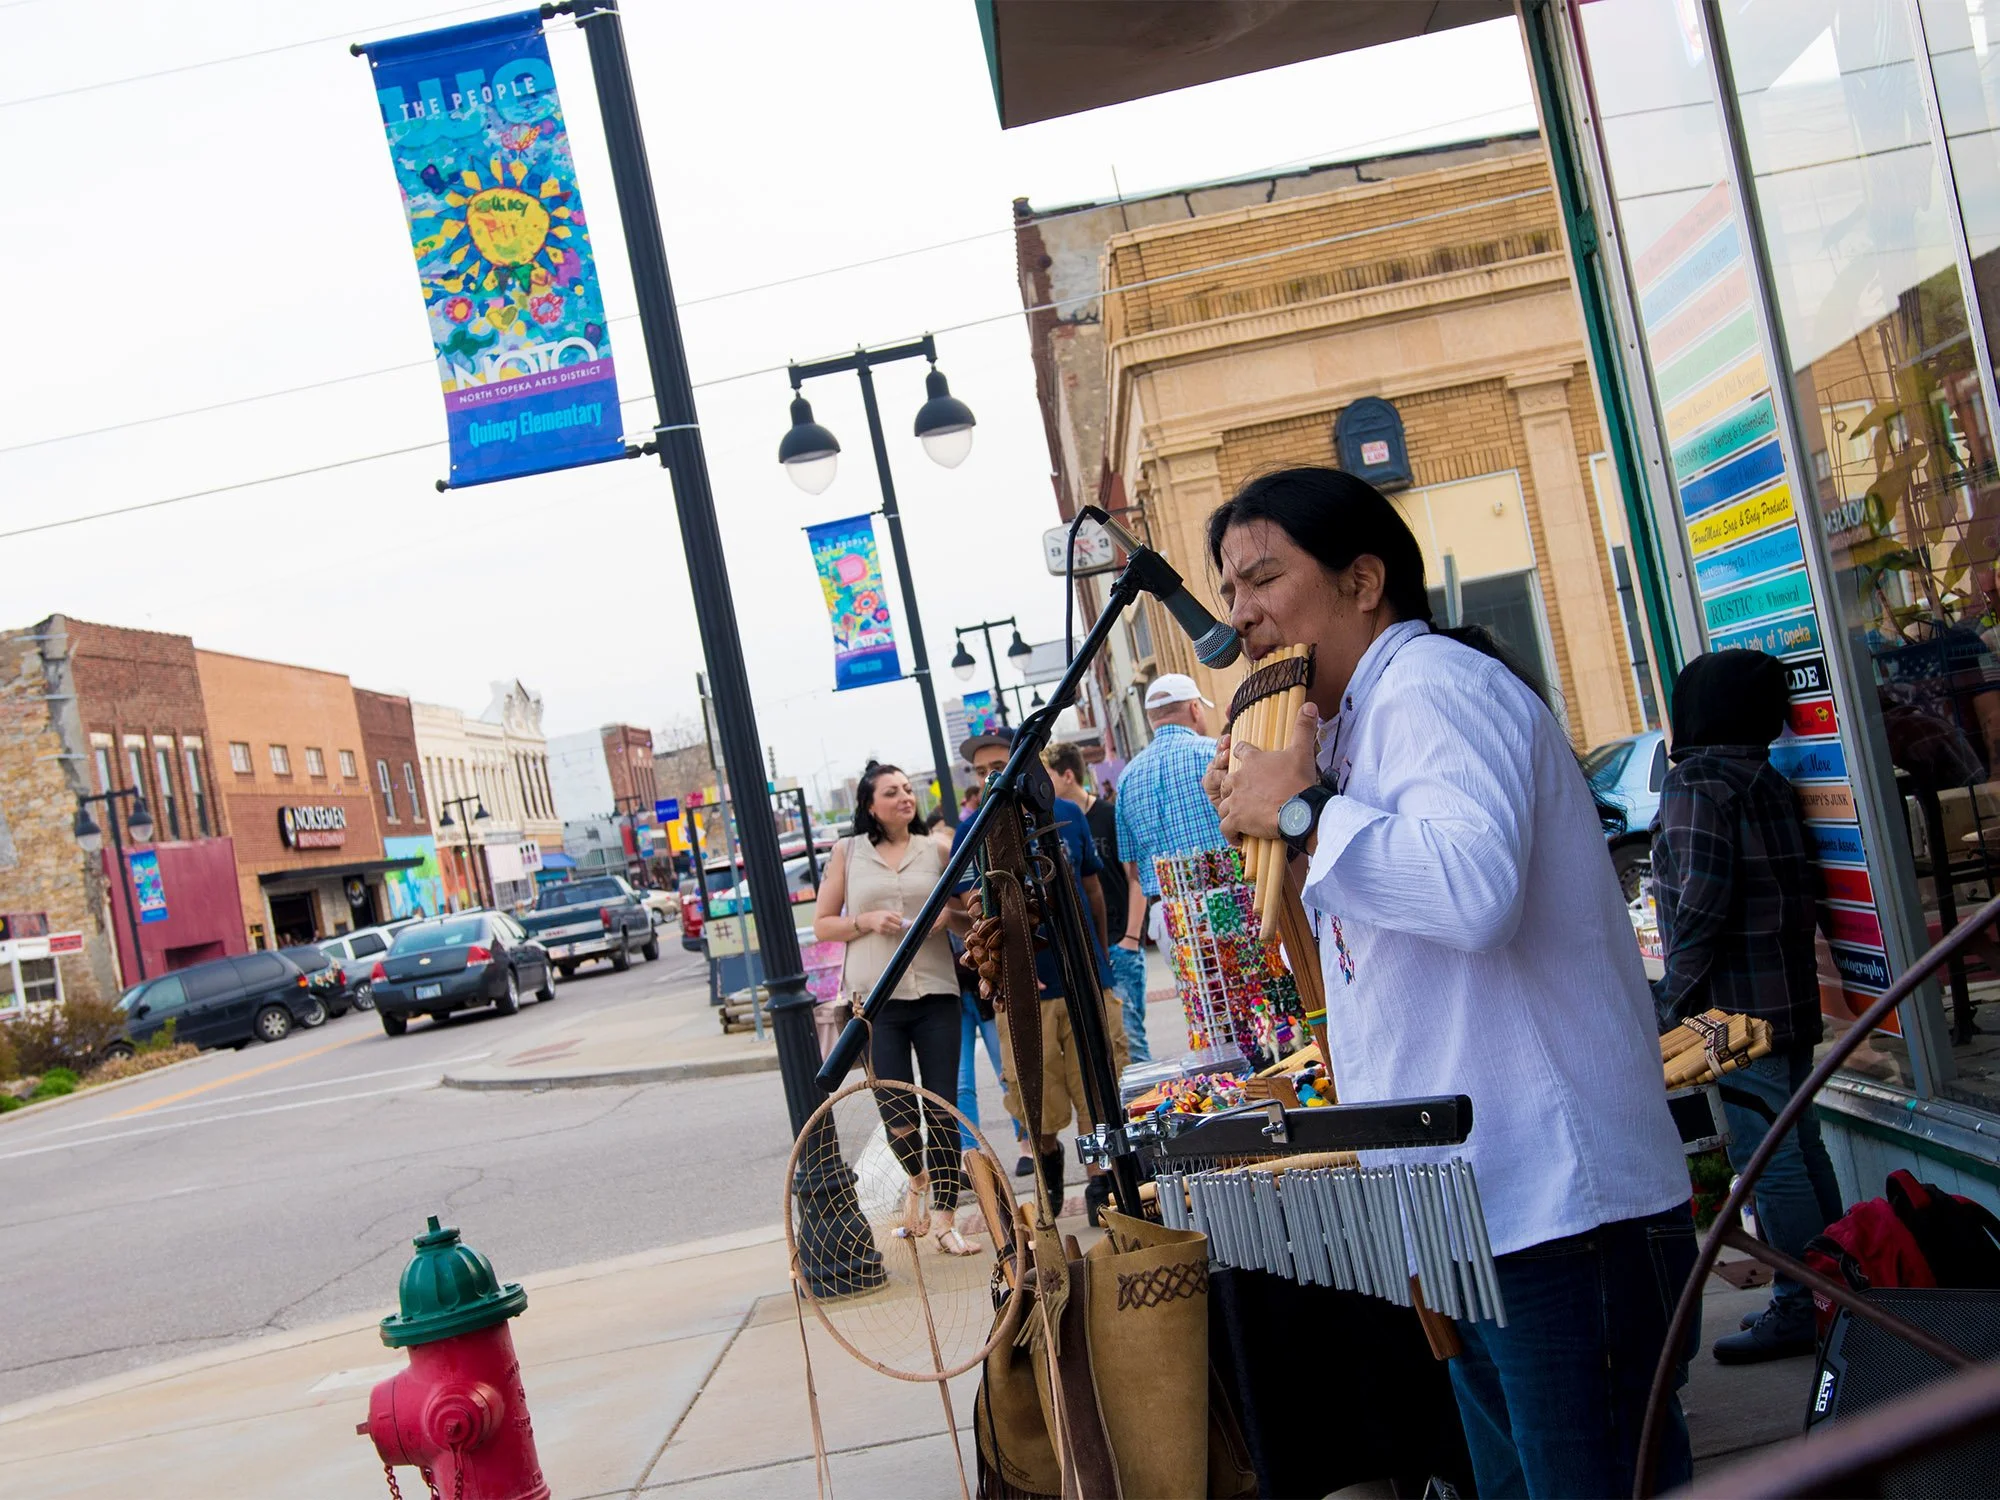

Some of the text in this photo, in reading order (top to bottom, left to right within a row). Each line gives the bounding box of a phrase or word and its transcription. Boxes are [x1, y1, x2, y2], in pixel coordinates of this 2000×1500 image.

[400, 76, 536, 121] THE PEOPLE
[459, 365, 601, 404] NORTH TOPEKA ARTS DISTRICT
[469, 402, 602, 448] Quincy Elementary
[1723, 519, 1738, 537] Soap
[1739, 511, 1745, 527] &
[1744, 508, 1760, 525] Body
[1761, 498, 1789, 519] Products
[1710, 594, 1753, 625] RUSTIC
[1765, 584, 1800, 607] Whimsical
[1744, 632, 1763, 652] Lady
[1766, 629, 1775, 649] of
[1777, 622, 1811, 649] Topeka
[294, 806, 347, 830] NORSEMEN
[1830, 792, 1849, 807] JUNK
[1819, 1370, 1835, 1413] ALTO
